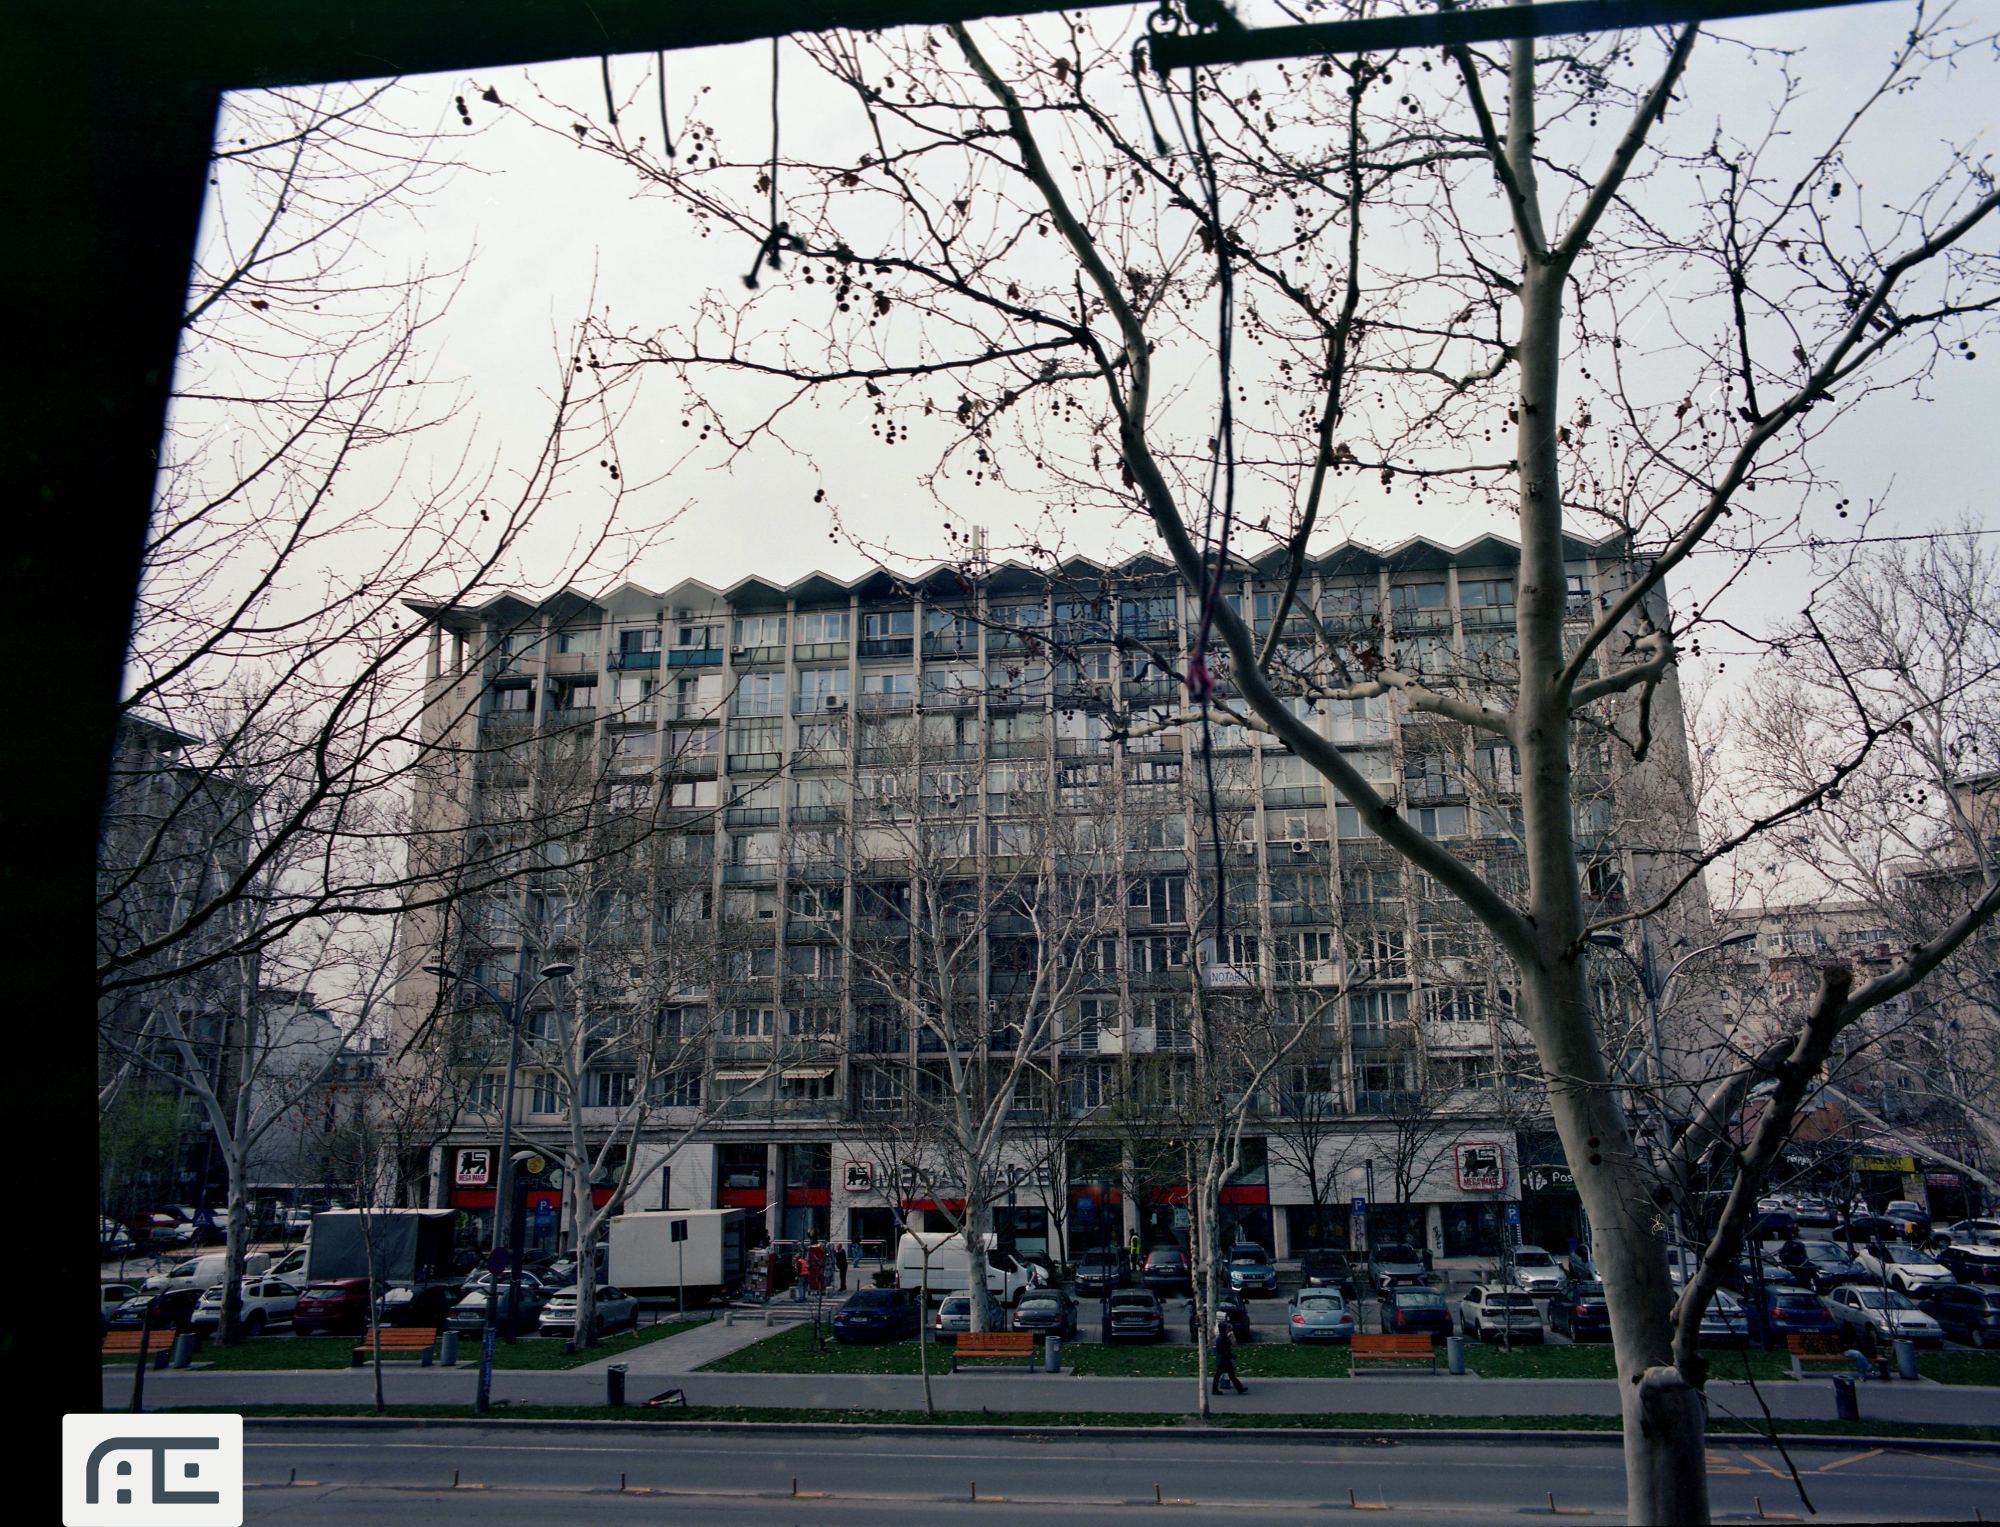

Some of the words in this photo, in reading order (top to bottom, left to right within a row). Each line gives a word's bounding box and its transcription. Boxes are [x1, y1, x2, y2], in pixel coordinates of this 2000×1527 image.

[540, 1201, 547, 1210] P
[1355, 1200, 1362, 1210] P
[1508, 1208, 1516, 1219] P
